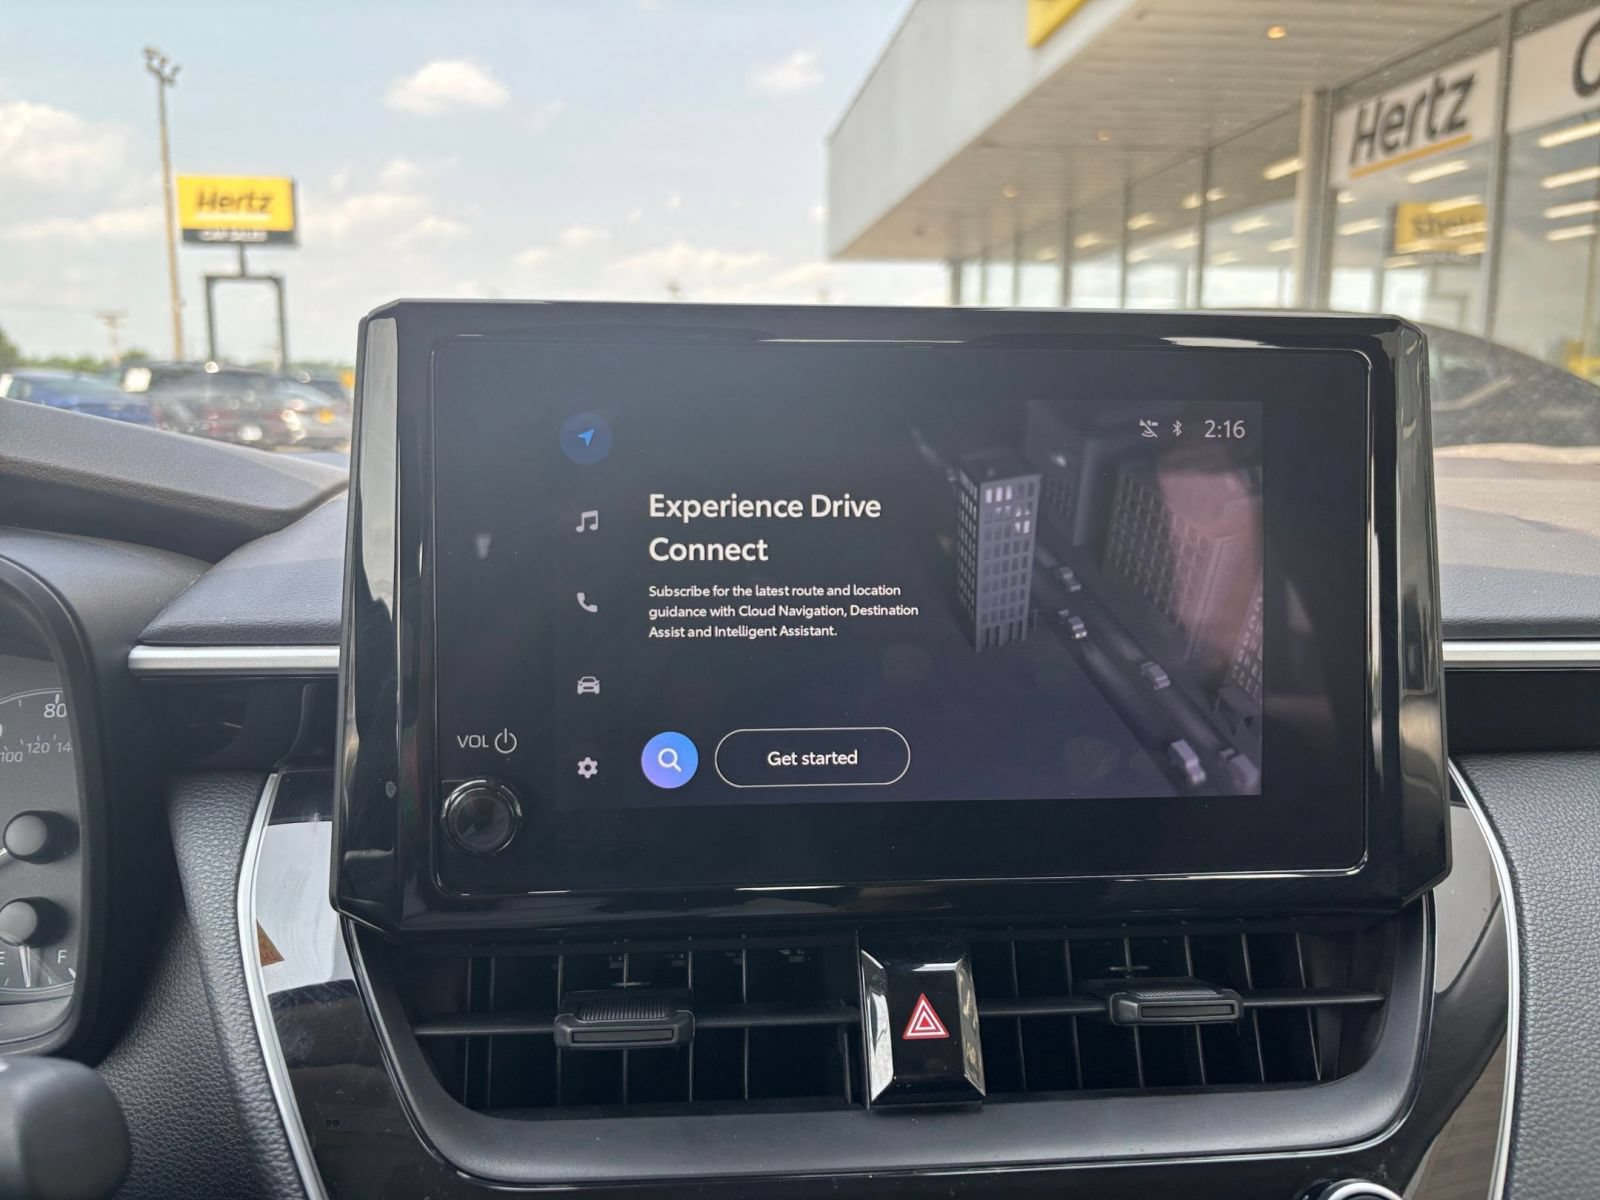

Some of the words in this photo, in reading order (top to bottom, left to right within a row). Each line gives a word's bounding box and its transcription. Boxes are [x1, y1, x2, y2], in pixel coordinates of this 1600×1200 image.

[1350, 73, 1475, 166] Hertz
[197, 190, 272, 213] Hertz
[1204, 419, 1246, 439] 2:16
[649, 493, 804, 523] Experience
[811, 493, 882, 518] Drive
[649, 537, 769, 561] Connect
[649, 585, 710, 597] Subscribe
[713, 585, 730, 597] for
[732, 585, 752, 597] the
[755, 585, 789, 597] latest
[792, 586, 824, 596] route
[827, 584, 850, 596] and
[853, 584, 901, 596] location
[649, 606, 707, 620] guidance
[710, 606, 736, 617] with
[738, 605, 776, 617] Cloud
[778, 605, 848, 619] Navigation,
[850, 604, 919, 616] Destination
[649, 626, 685, 638] Assist
[687, 626, 711, 638] and
[715, 625, 777, 640] Intelligent
[780, 625, 837, 637] Assistant.
[43, 703, 67, 718] 80
[457, 735, 489, 749] VOL
[0, 751, 23, 763] 100
[26, 742, 50, 754] 120
[56, 742, 73, 753] 14
[767, 750, 797, 766] Get
[801, 749, 858, 765] started
[57, 950, 67, 964] F
